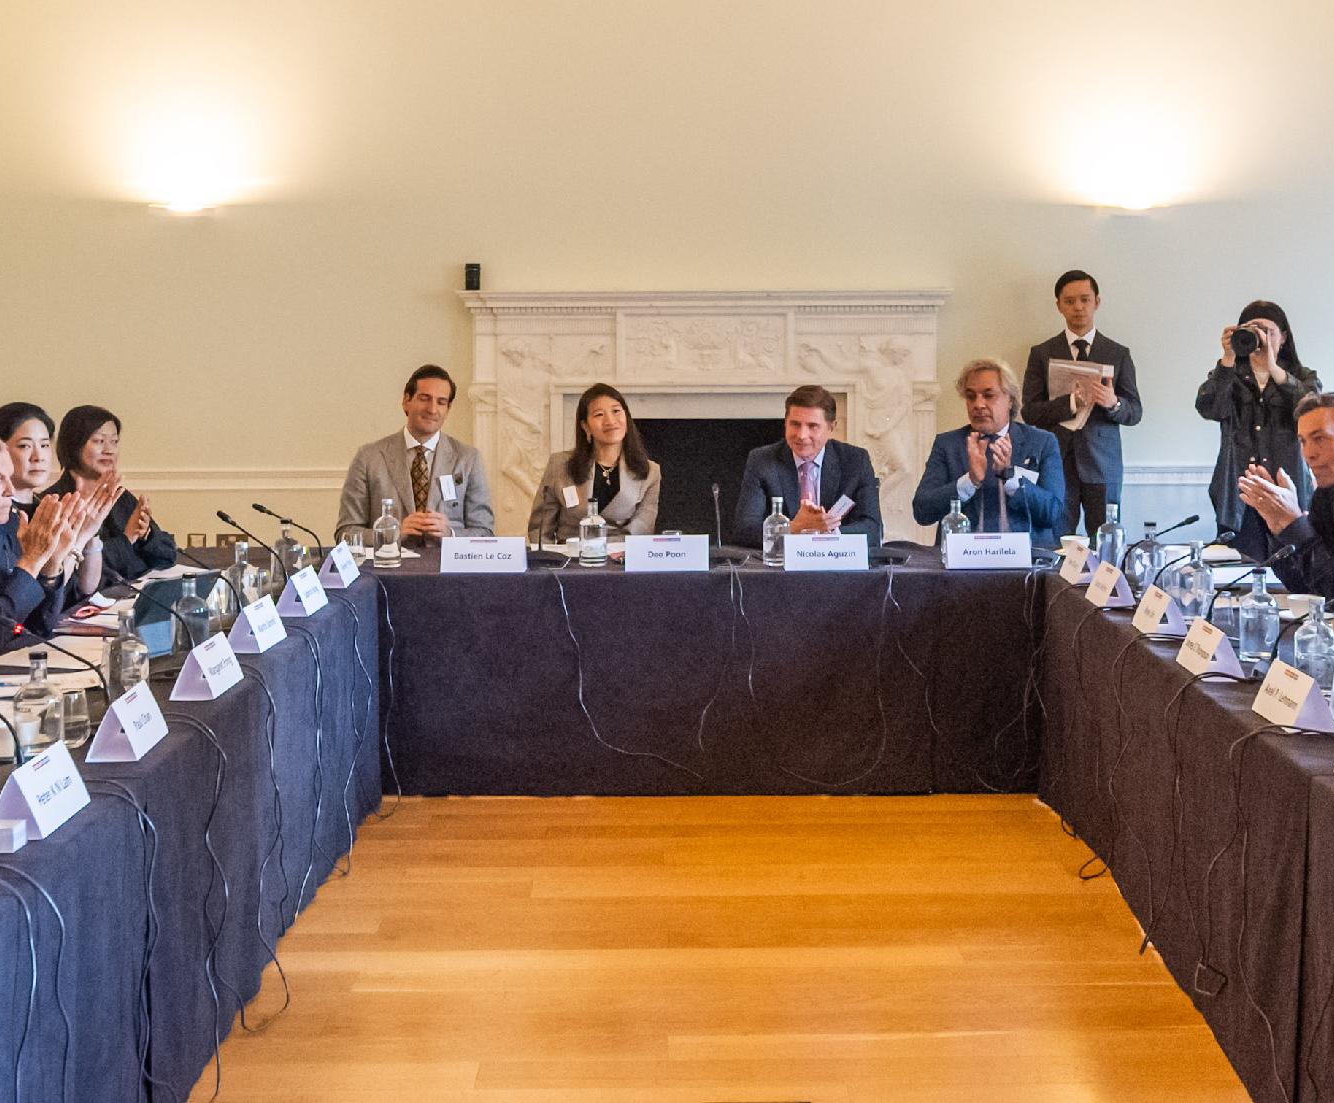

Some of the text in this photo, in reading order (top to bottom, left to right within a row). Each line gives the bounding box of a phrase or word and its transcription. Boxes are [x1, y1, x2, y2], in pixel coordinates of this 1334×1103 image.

[454, 552, 483, 560] Bastien
[485, 552, 495, 560] Le
[797, 550, 825, 558] Nicolas
